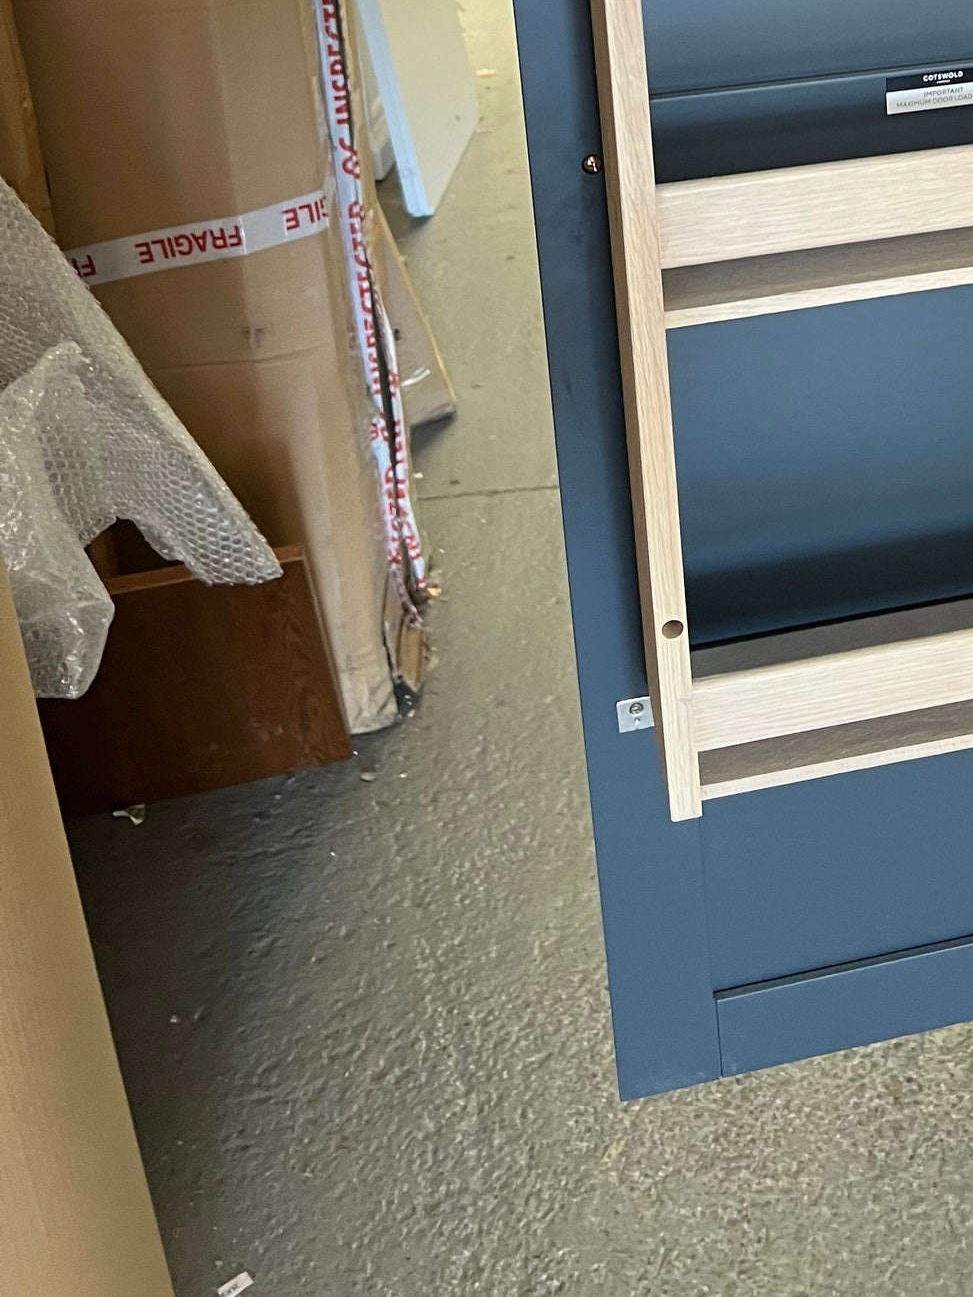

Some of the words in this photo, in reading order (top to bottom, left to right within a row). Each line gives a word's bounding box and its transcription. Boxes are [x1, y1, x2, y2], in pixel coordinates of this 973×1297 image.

[922, 70, 964, 82] COTSWOLD
[923, 86, 964, 98] IMPORTANT
[896, 99, 931, 109] MAXIMUM
[954, 93, 973, 102] LOAD
[135, 225, 243, 264] FRAGILE
